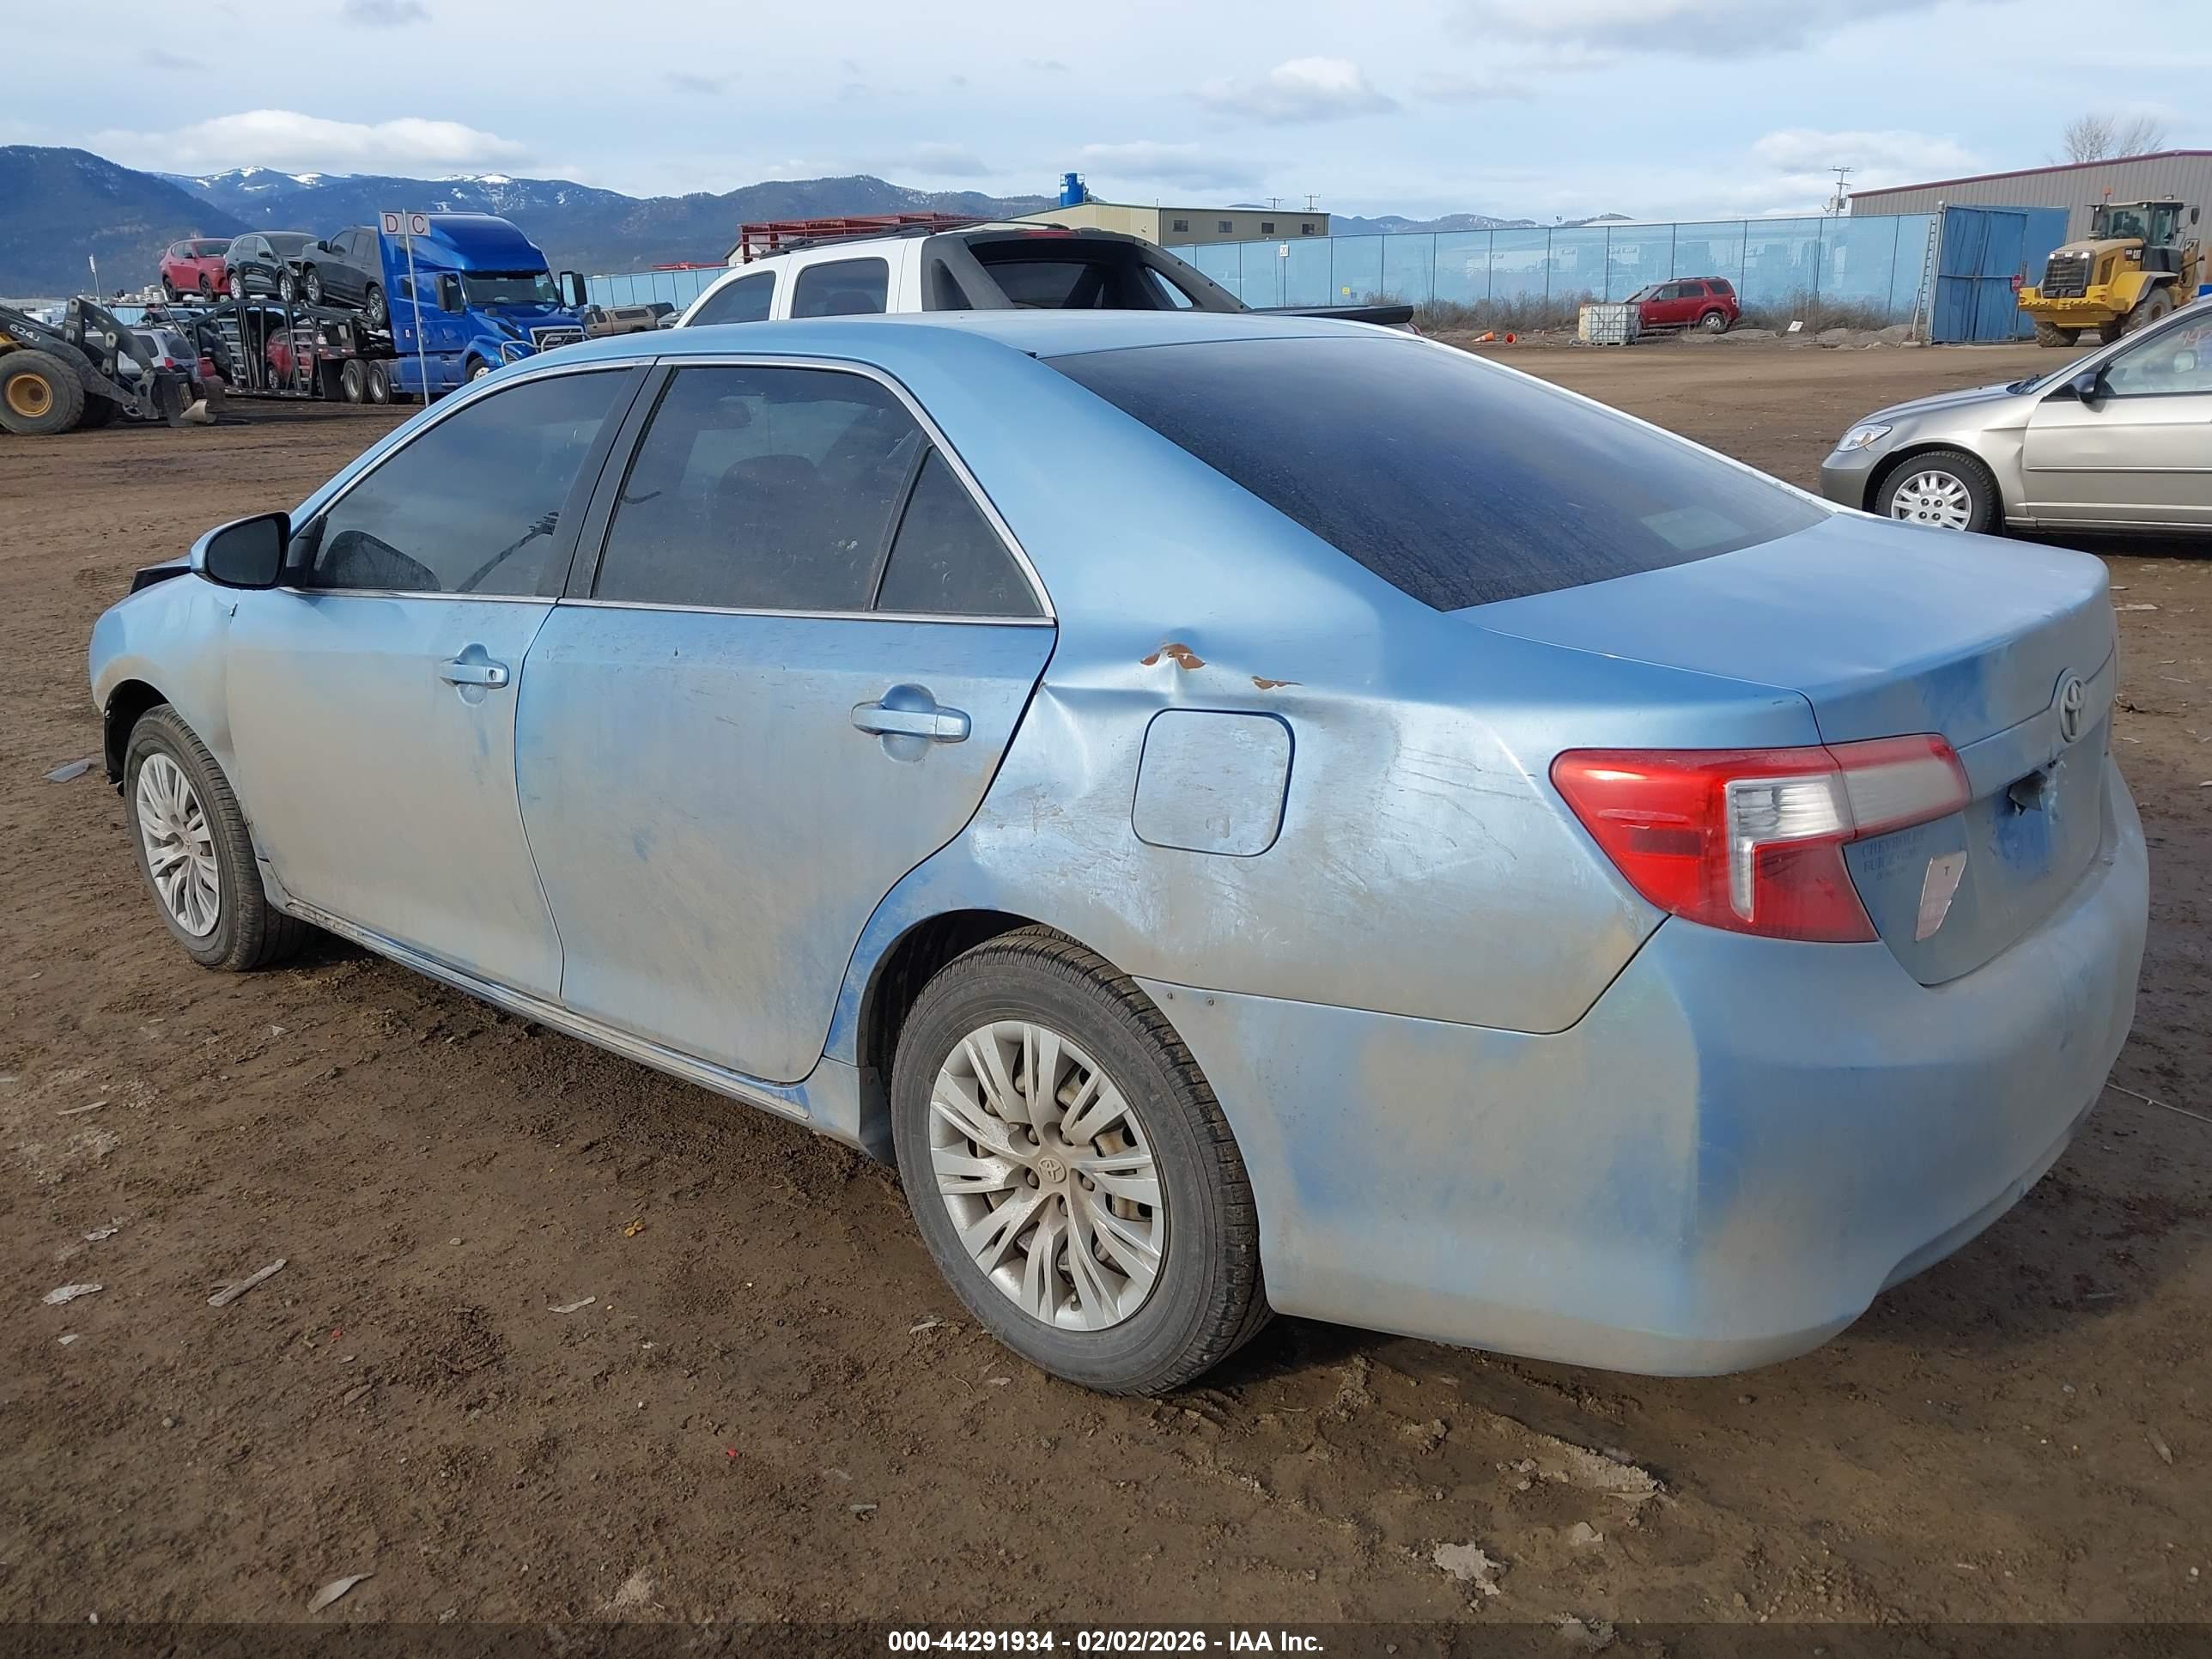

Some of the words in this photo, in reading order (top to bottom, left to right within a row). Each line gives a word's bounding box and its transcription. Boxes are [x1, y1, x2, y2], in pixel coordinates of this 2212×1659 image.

[385, 214, 398, 233] D
[412, 215, 425, 234] C
[9, 323, 40, 342] 624J
